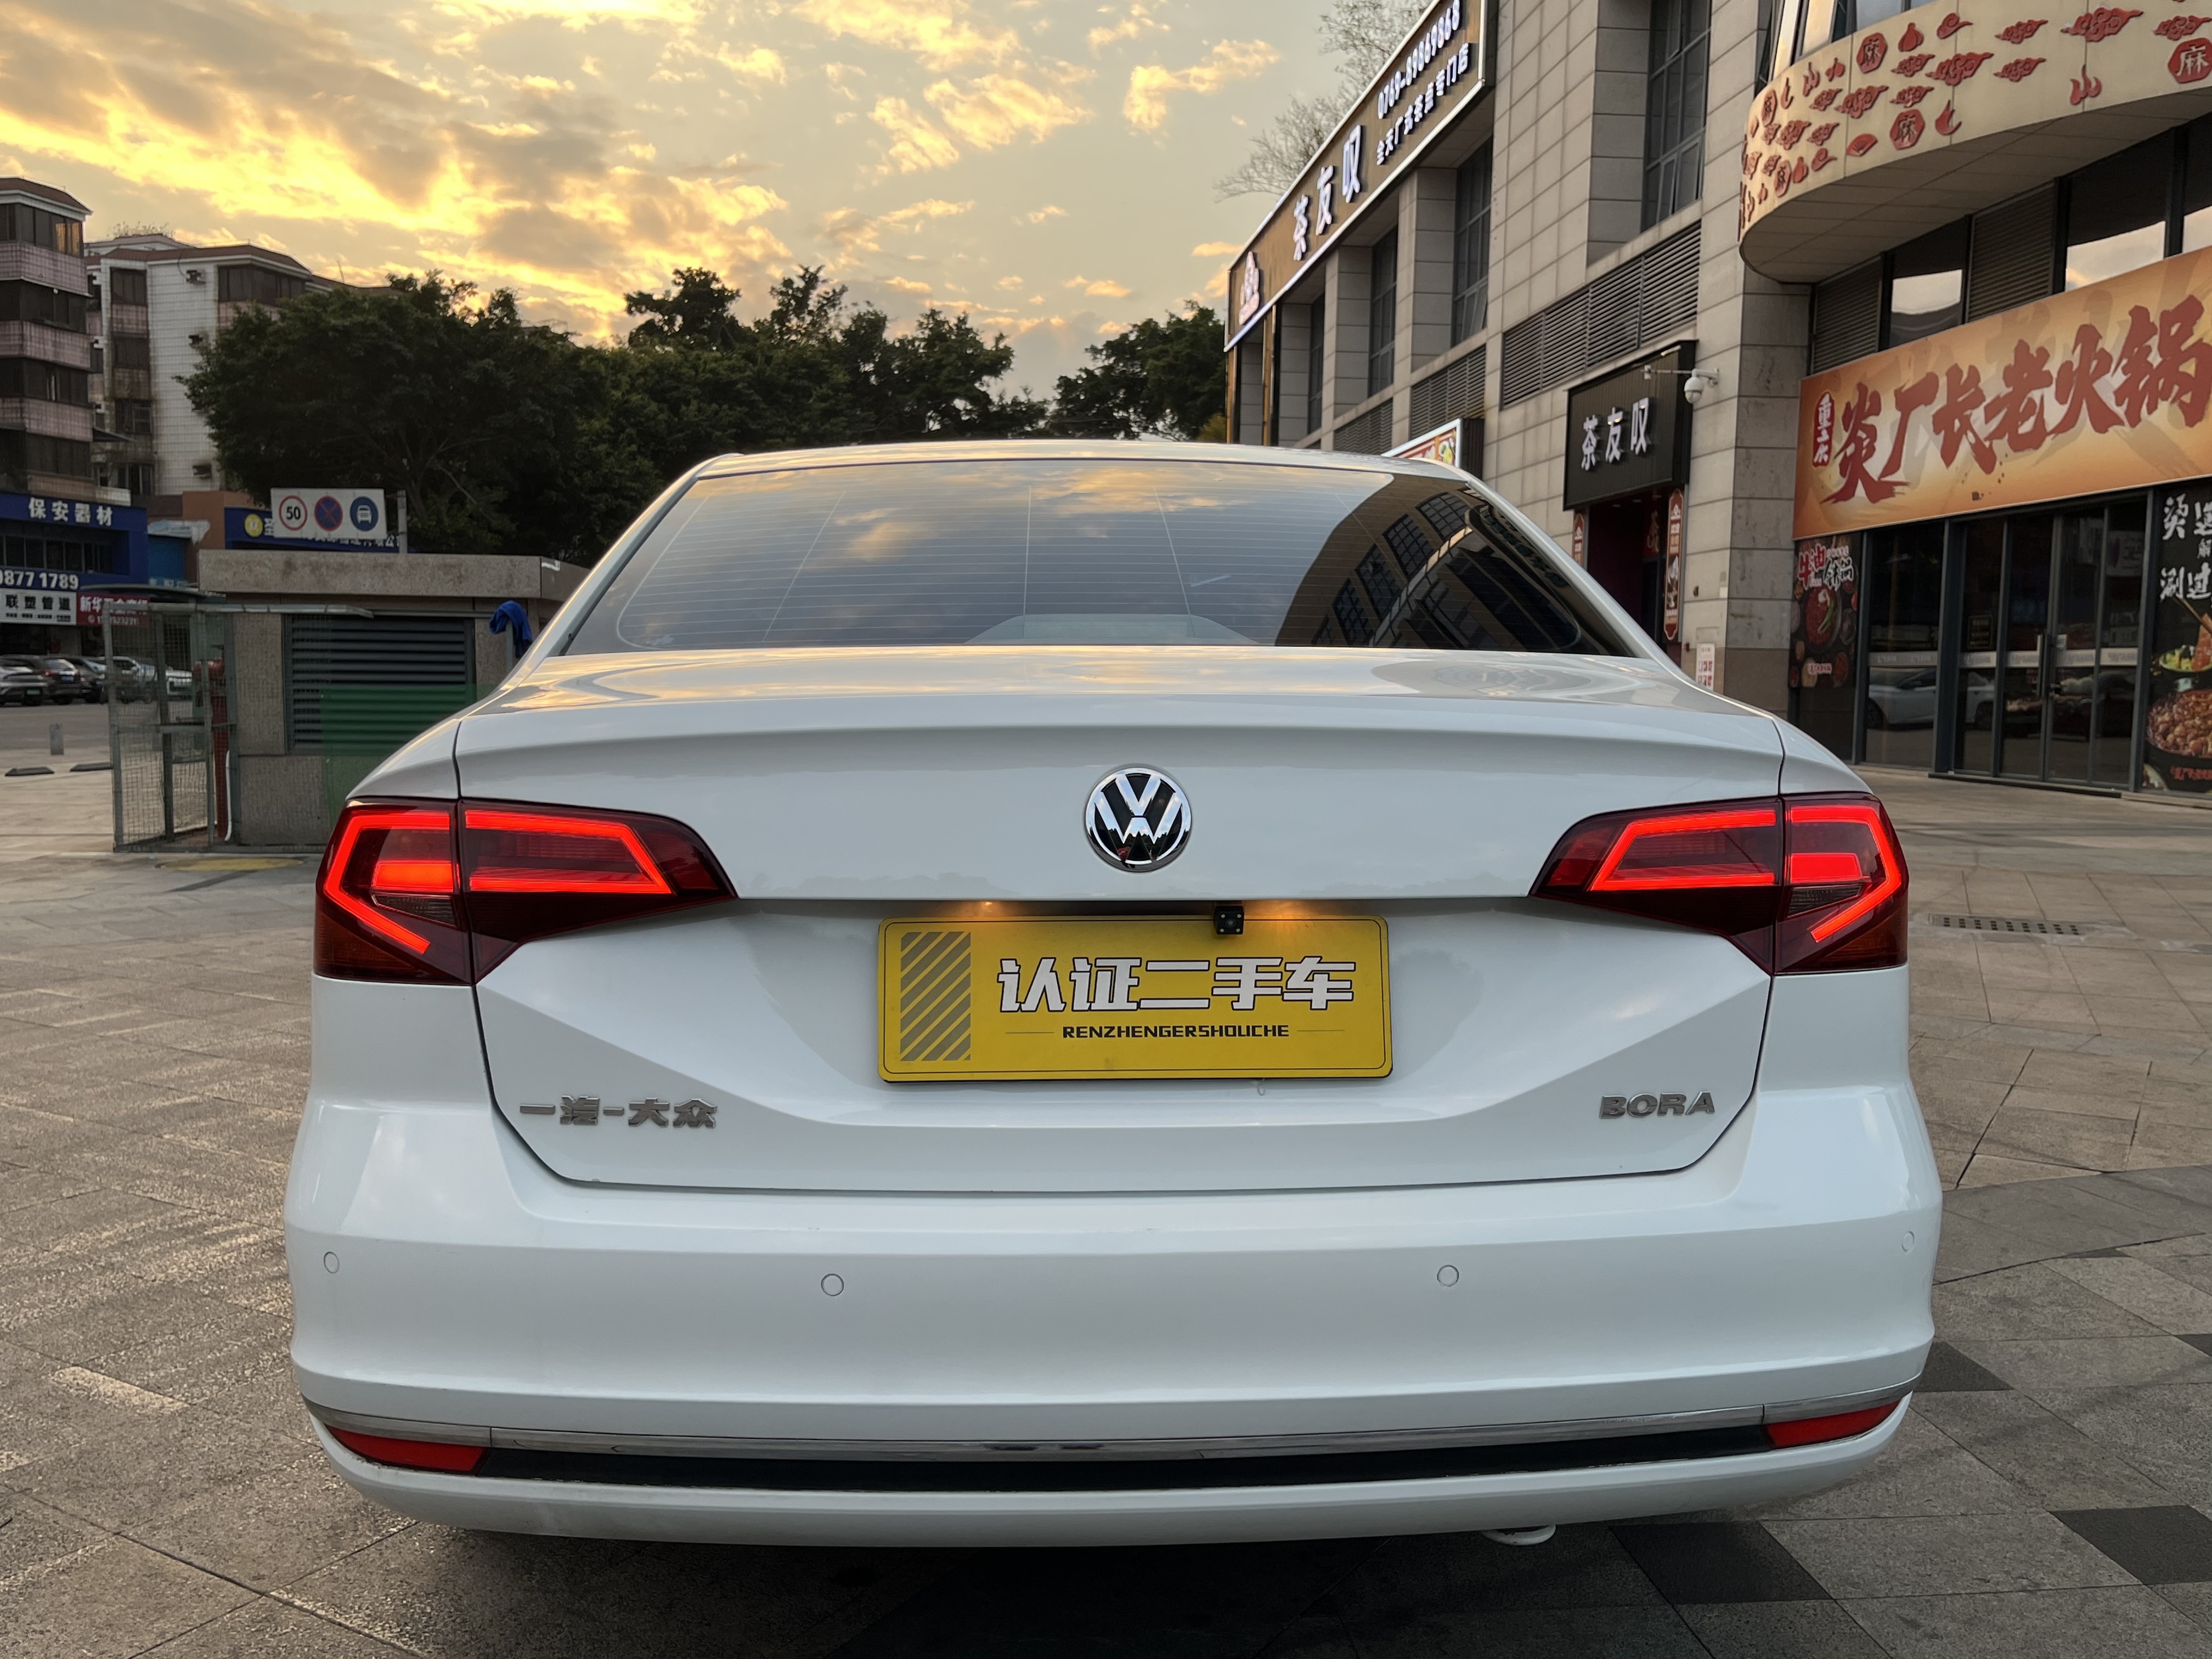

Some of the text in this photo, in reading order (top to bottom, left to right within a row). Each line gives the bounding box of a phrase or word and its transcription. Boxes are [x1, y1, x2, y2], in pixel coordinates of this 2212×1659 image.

[2176, 46, 2209, 76] 麻
[1894, 114, 1917, 143] 麻
[1293, 124, 1361, 261] 茶友叹
[1820, 294, 2212, 504] 炎厂长老火锅
[1581, 397, 1649, 471] 茶友叹
[29, 496, 113, 526] 保安器材
[286, 506, 301, 520] 50
[39, 572, 79, 590] 1789
[996, 956, 1356, 1013] 认证二手车
[1063, 1025, 1290, 1039] RENZHENGERSHOUCHE
[1599, 1091, 1715, 1119] BORA
